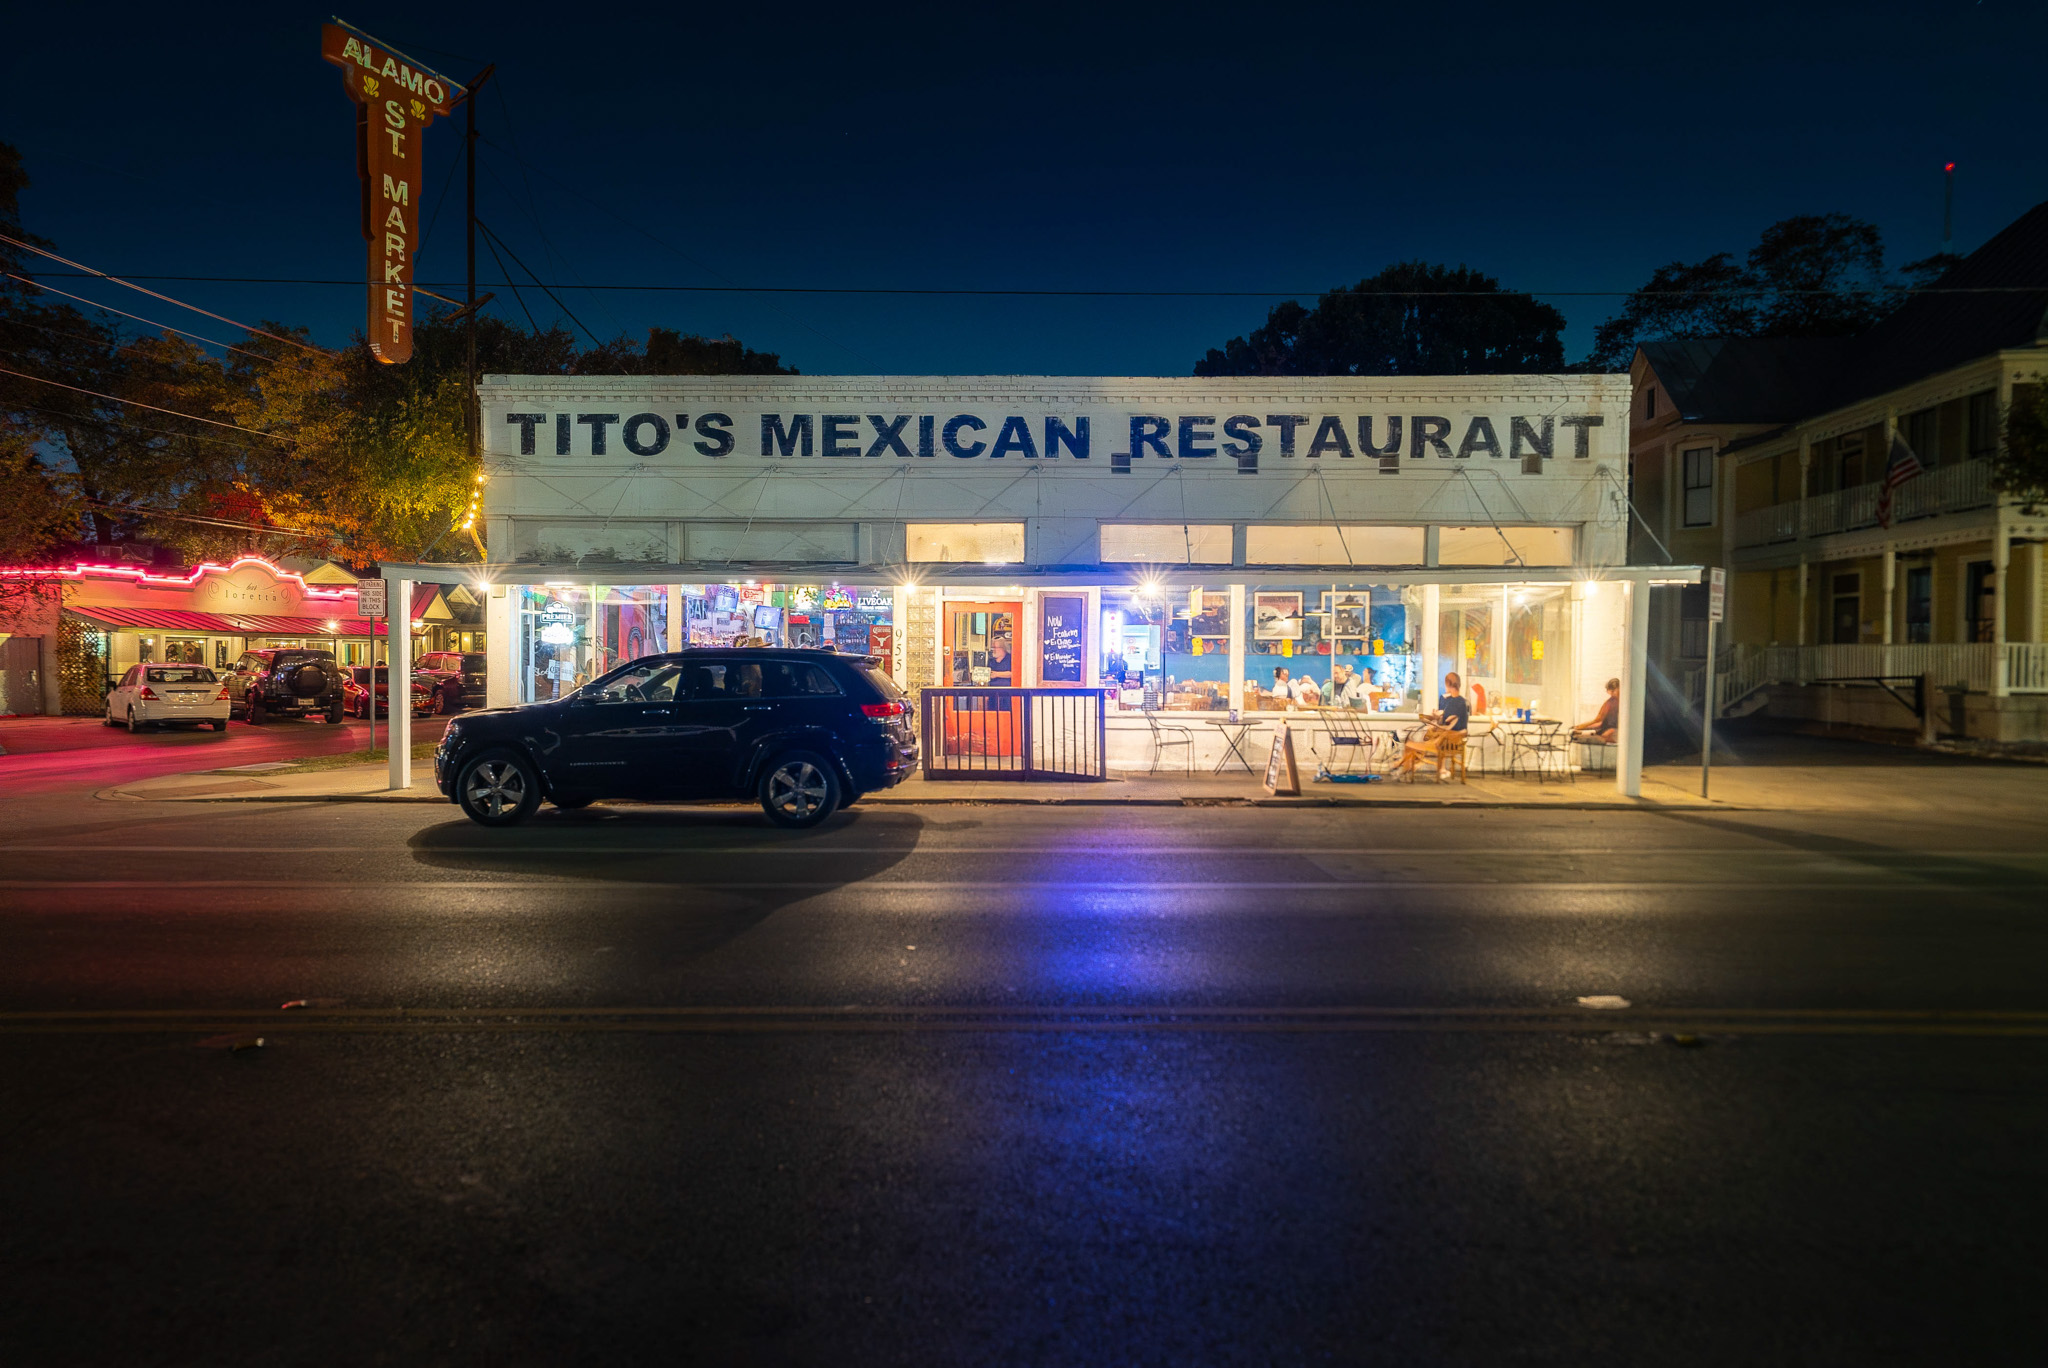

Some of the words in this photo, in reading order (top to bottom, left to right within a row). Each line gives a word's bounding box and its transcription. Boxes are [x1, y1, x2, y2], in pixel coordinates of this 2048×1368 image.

[342, 37, 445, 105] ALAMO
[385, 100, 406, 159] ST.
[383, 173, 408, 344] MARKET
[506, 412, 736, 458] TITO'S
[761, 413, 1091, 460] MEXICAN
[1129, 414, 1604, 460] RESTAURANT
[225, 589, 277, 601] loretta
